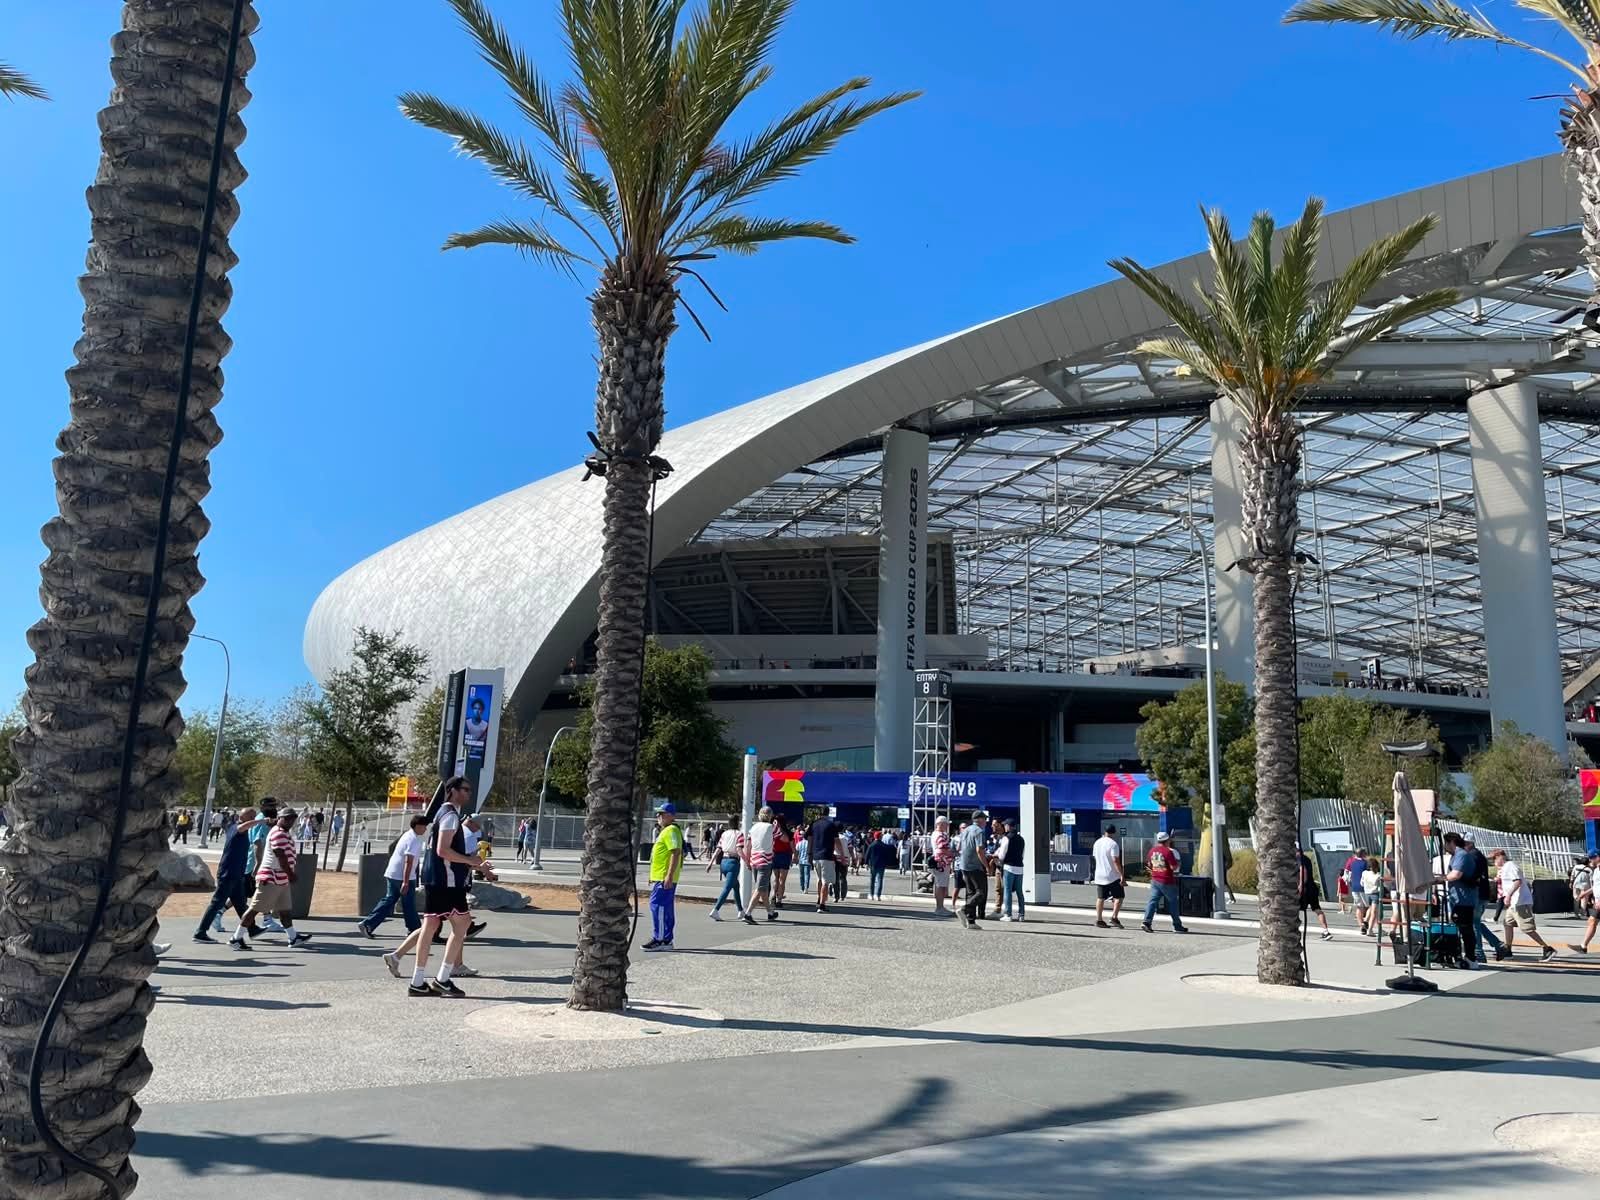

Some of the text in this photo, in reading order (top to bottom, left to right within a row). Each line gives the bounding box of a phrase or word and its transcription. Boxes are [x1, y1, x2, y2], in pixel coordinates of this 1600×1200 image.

[906, 467, 919, 671] FIFA WORLD CUP 2026
[916, 673, 938, 682] ENTRY
[923, 682, 930, 694] 8
[942, 683, 948, 695] 8
[925, 782, 965, 796] ENTRY
[967, 782, 977, 797] 8
[1056, 862, 1078, 873] ONLY
